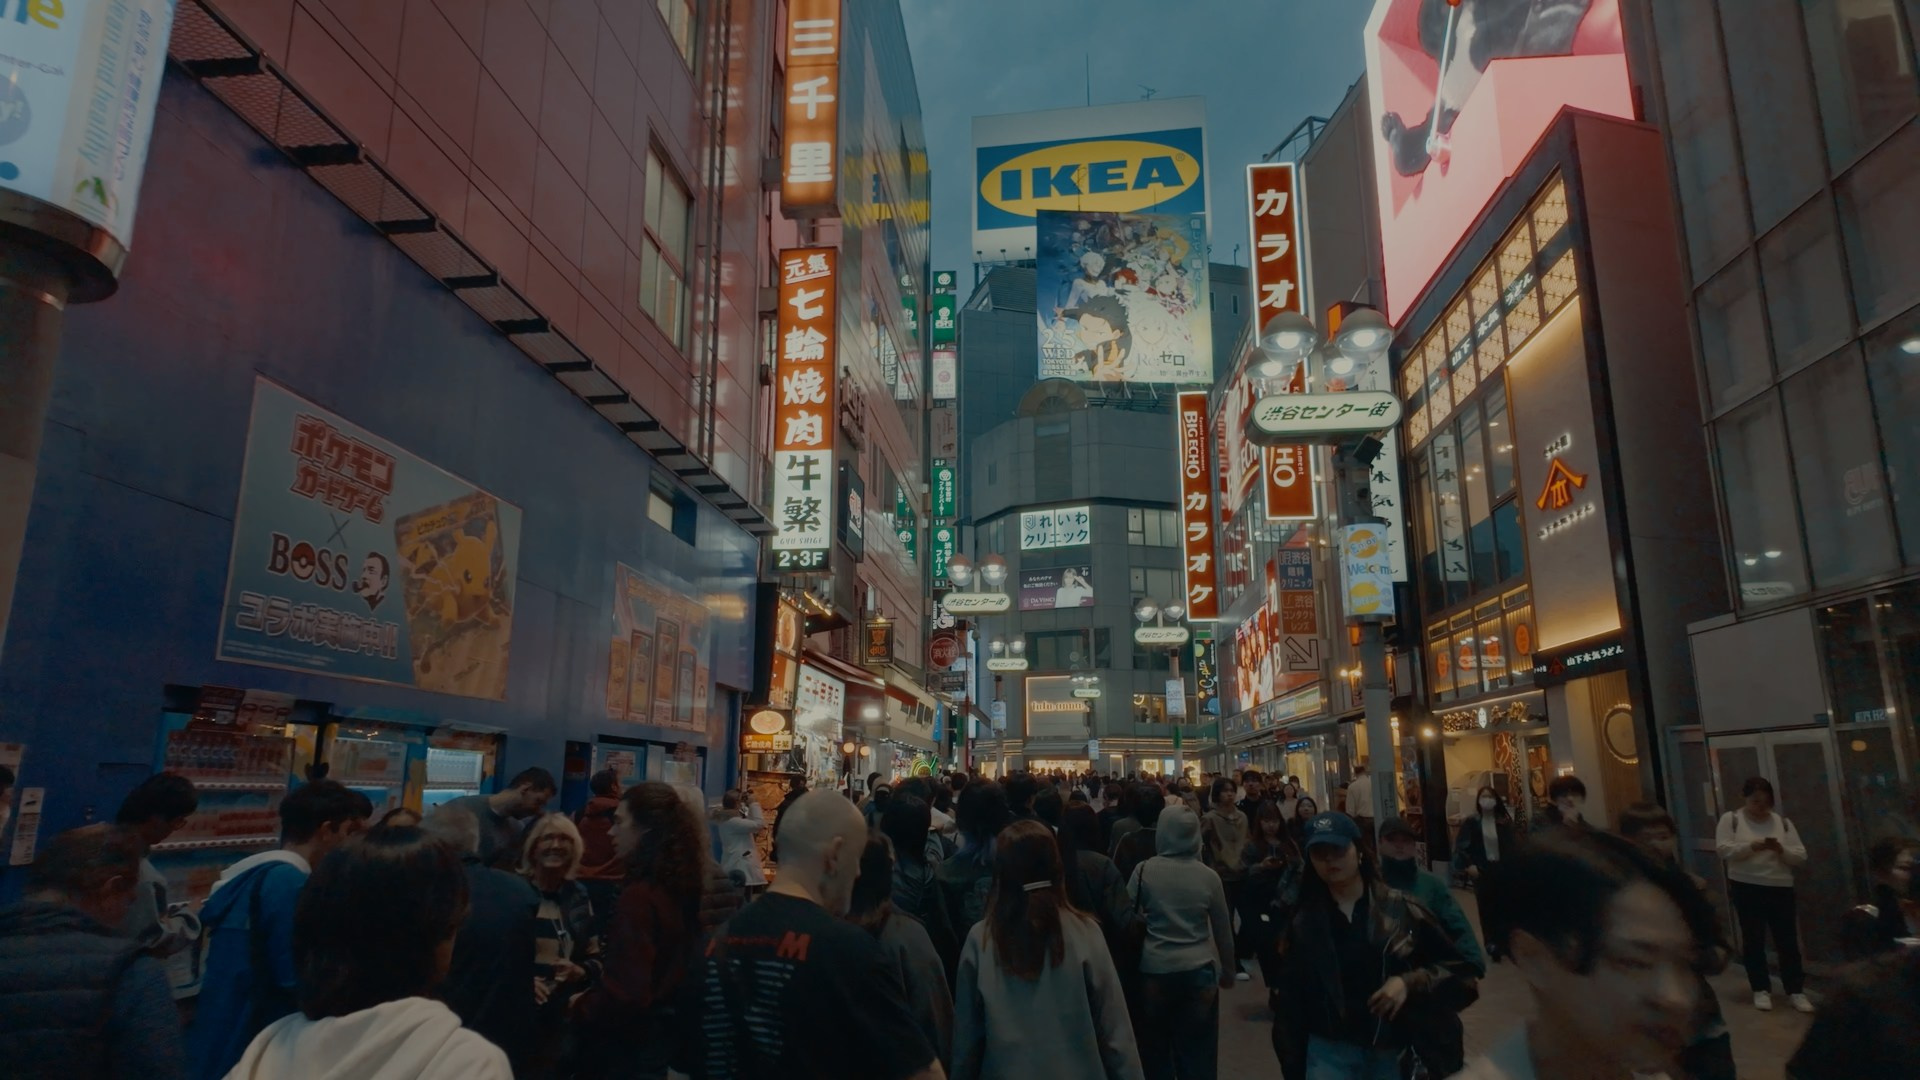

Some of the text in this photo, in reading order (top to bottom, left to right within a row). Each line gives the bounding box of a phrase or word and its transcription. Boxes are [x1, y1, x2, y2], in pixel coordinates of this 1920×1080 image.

[1001, 156, 1184, 201] IKEA
[1255, 189, 1294, 308] カラオ
[1262, 402, 1392, 421] 渋谷センター街
[1184, 411, 1201, 479] BIG ECHO
[782, 455, 822, 533] 牛繁
[1039, 511, 1089, 529] れいわ
[1024, 529, 1088, 547] クリニック
[1186, 491, 1213, 604] カラオケ
